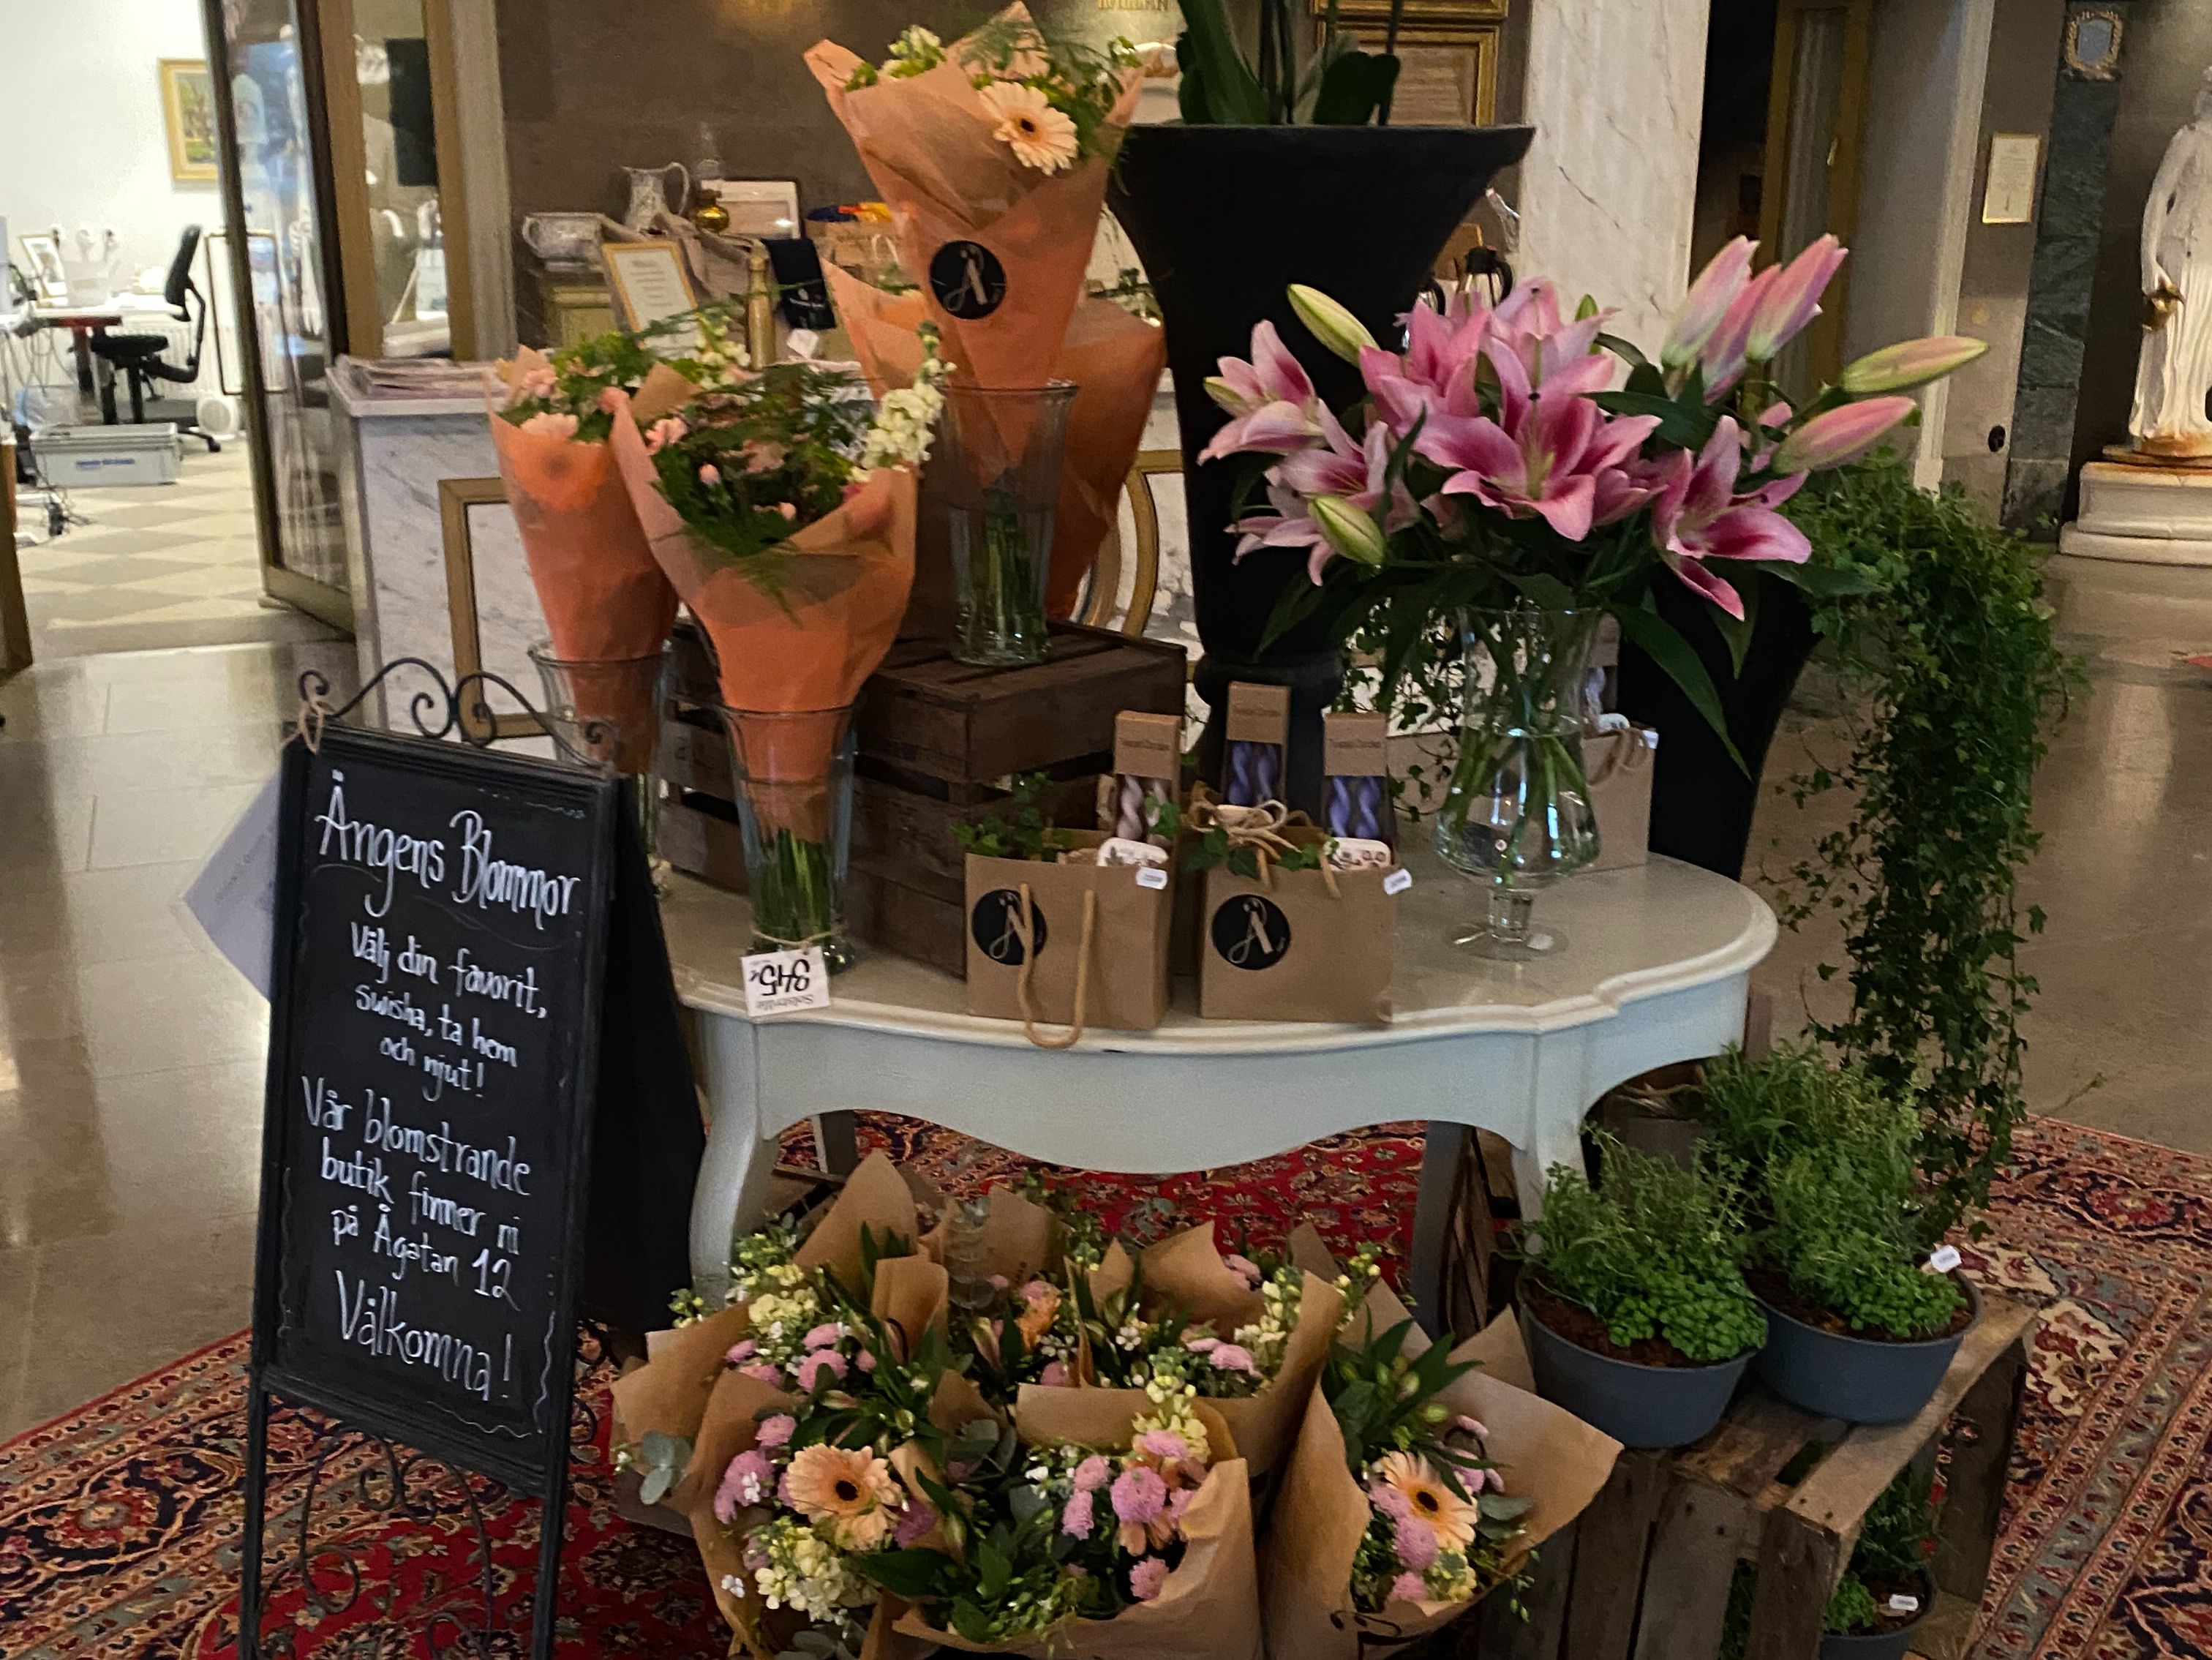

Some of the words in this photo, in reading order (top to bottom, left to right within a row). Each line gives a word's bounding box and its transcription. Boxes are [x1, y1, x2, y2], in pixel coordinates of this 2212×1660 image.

[449, 810, 581, 931] Blommor
[350, 922, 390, 984] Välj
[397, 935, 439, 985] din
[447, 948, 547, 1018] favorit,
[380, 1037, 415, 1066] och
[422, 1054, 484, 1102] njut!
[437, 1003, 462, 1045] ta
[472, 1018, 518, 1067] hem
[301, 1075, 353, 1131] Vår
[364, 1089, 531, 1196] blomstrande
[321, 1136, 395, 1203] butik
[408, 1171, 486, 1237] finner
[497, 1216, 521, 1255] ni
[331, 1204, 359, 1246] på
[373, 1203, 460, 1287] Ågatan
[472, 1248, 521, 1312] 12
